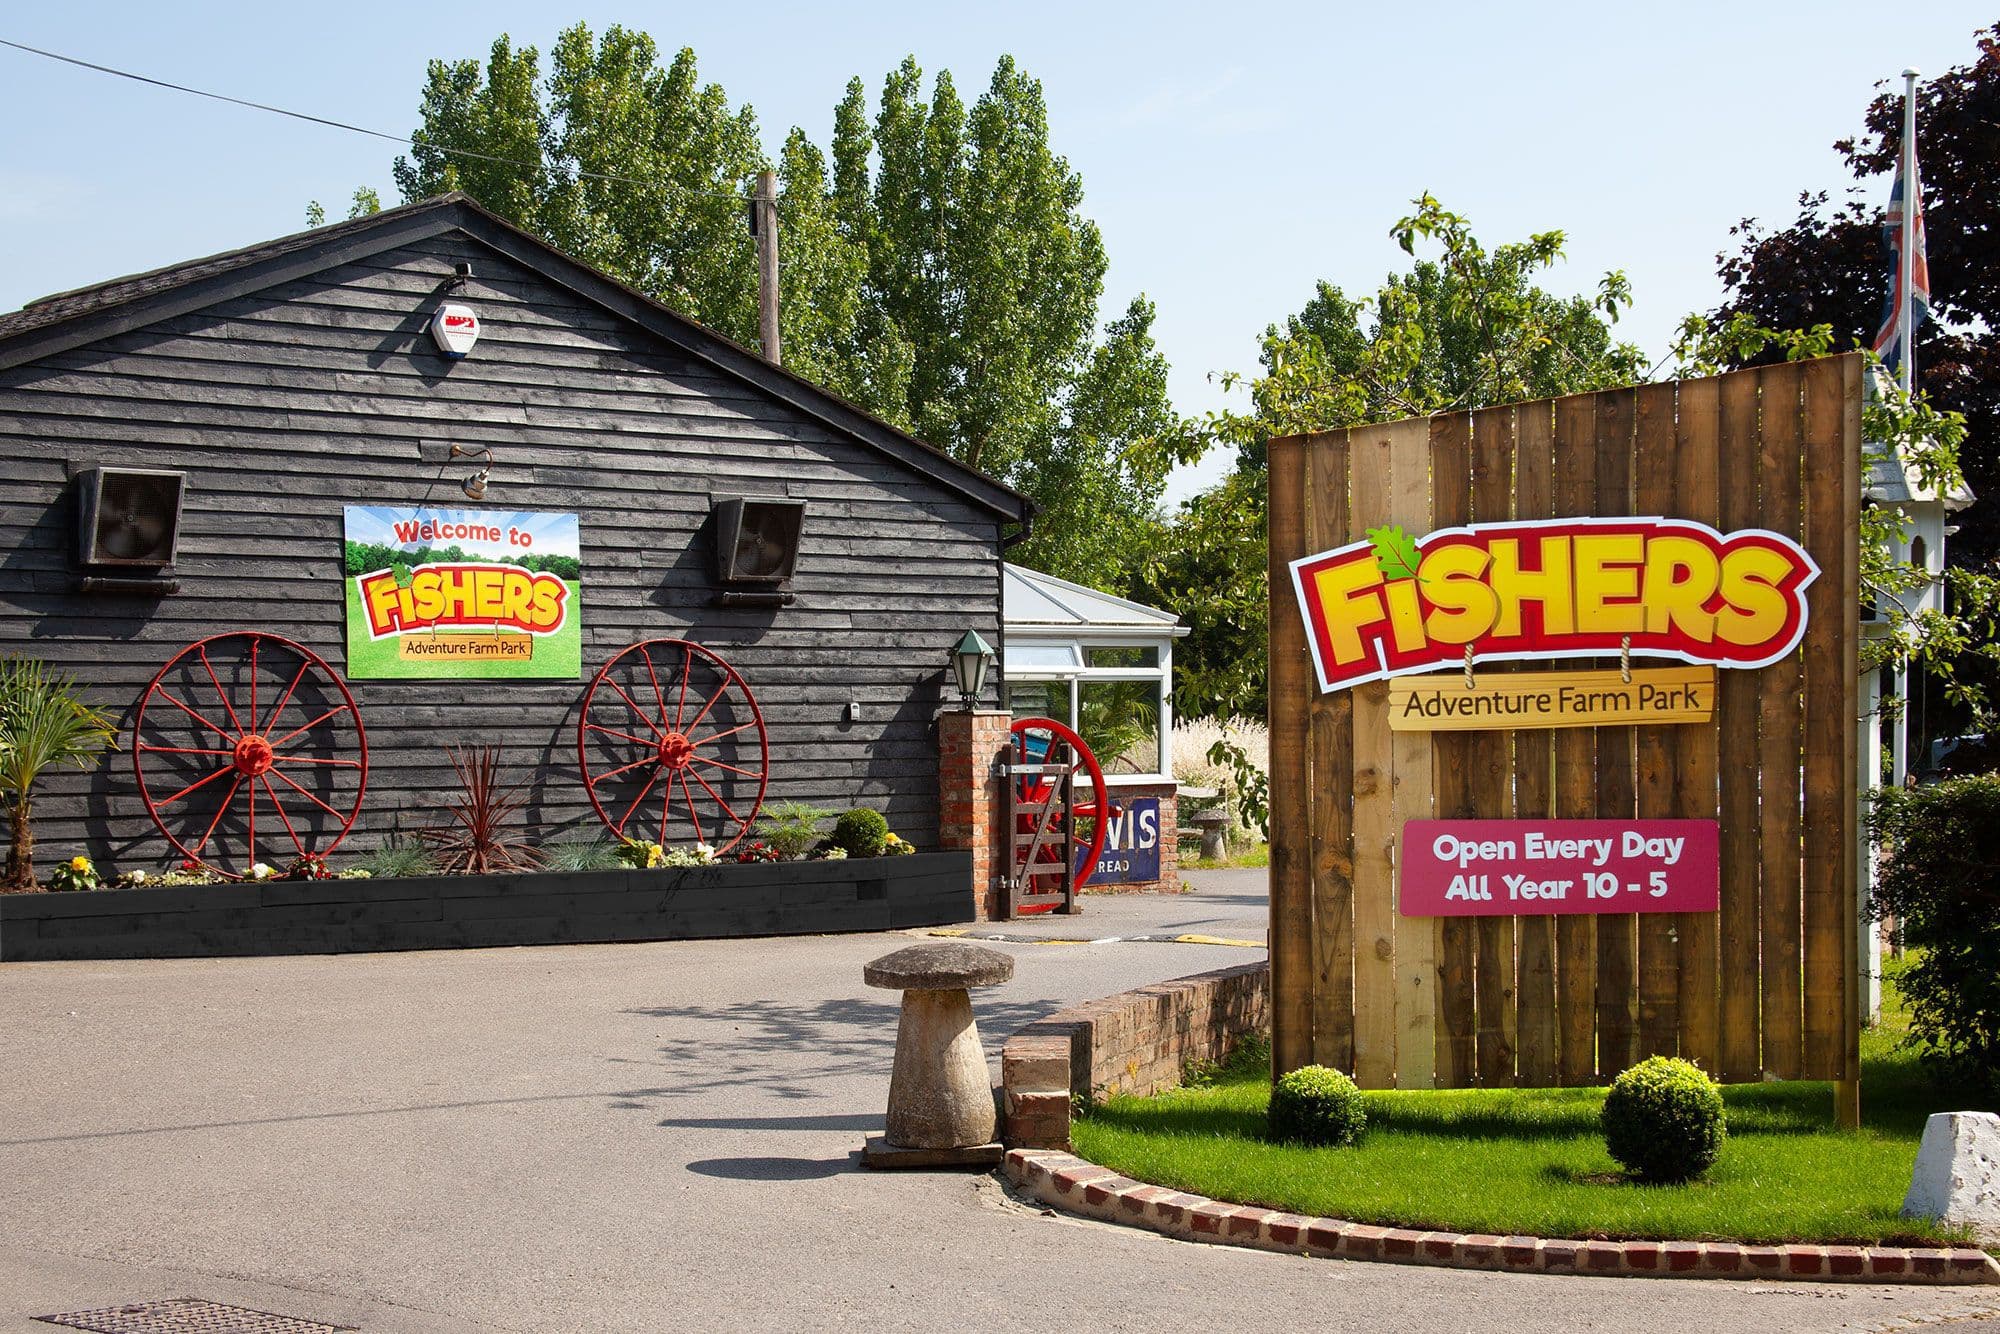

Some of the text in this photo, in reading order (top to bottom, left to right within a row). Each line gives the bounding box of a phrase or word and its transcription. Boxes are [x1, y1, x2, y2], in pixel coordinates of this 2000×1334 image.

[394, 520, 532, 547] Welcome to
[406, 641, 526, 655] Adventure Farm Park
[1403, 684, 1700, 718] Adventure Farm Park
[1106, 809, 1156, 850] VIS
[1433, 831, 1685, 867] Open Every Day
[1096, 860, 1130, 873] READ
[1445, 873, 1492, 901] All
[1502, 873, 1574, 901] Year
[1582, 872, 1618, 899] 10
[1649, 871, 1668, 897] 5
